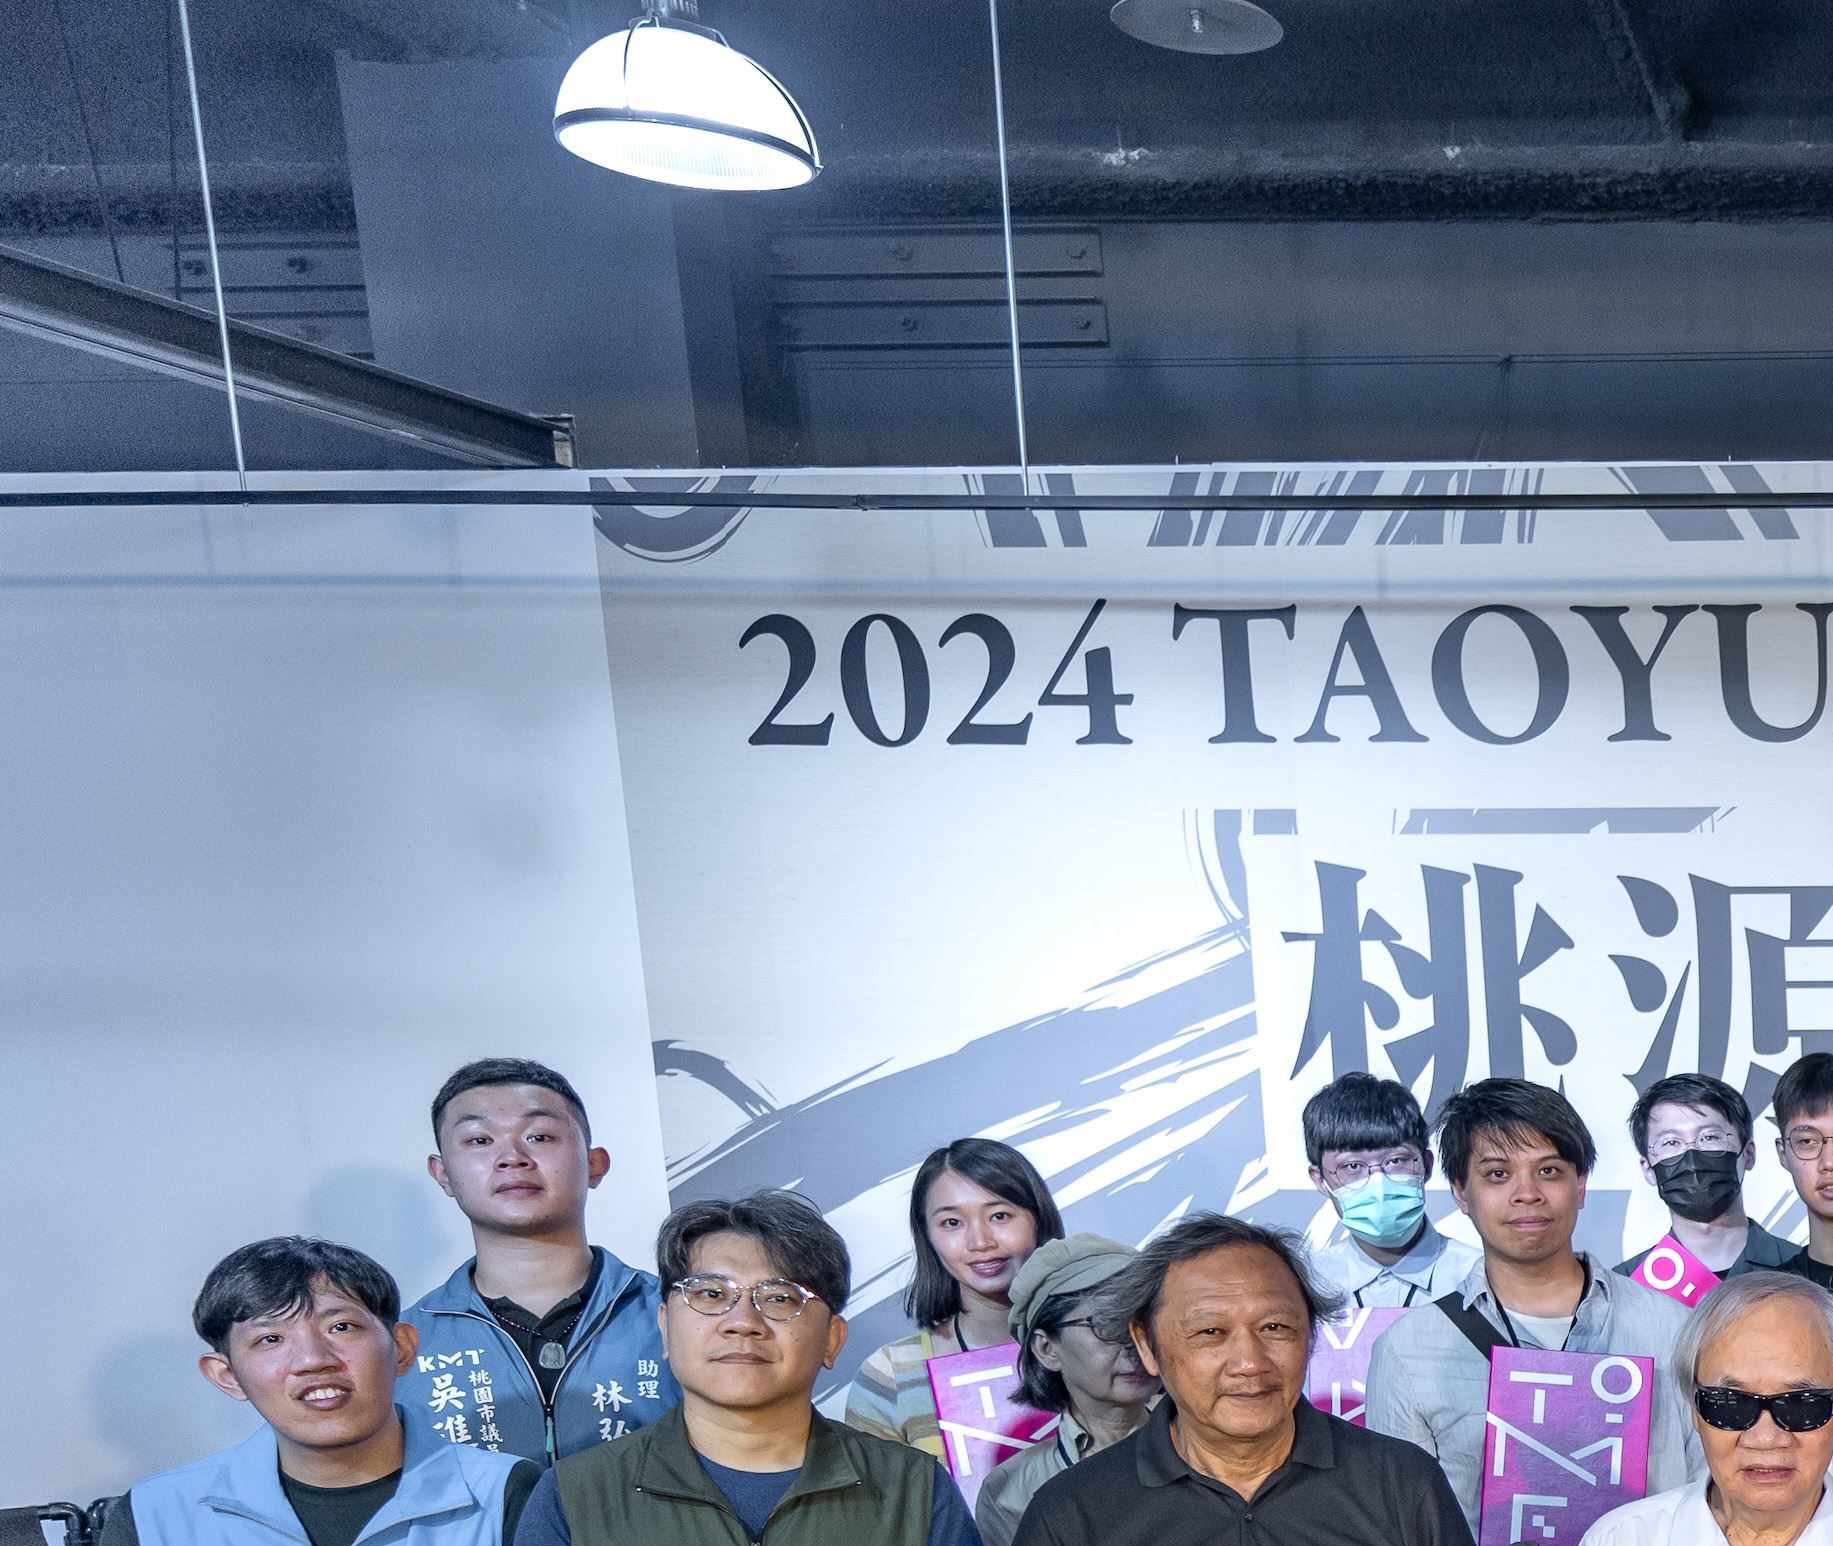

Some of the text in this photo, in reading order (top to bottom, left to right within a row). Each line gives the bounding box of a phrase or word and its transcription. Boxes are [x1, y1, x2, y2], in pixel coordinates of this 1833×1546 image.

[739, 597, 1134, 748] 2024
[417, 1349, 485, 1373] KMT
[637, 1359, 661, 1399] 助理
